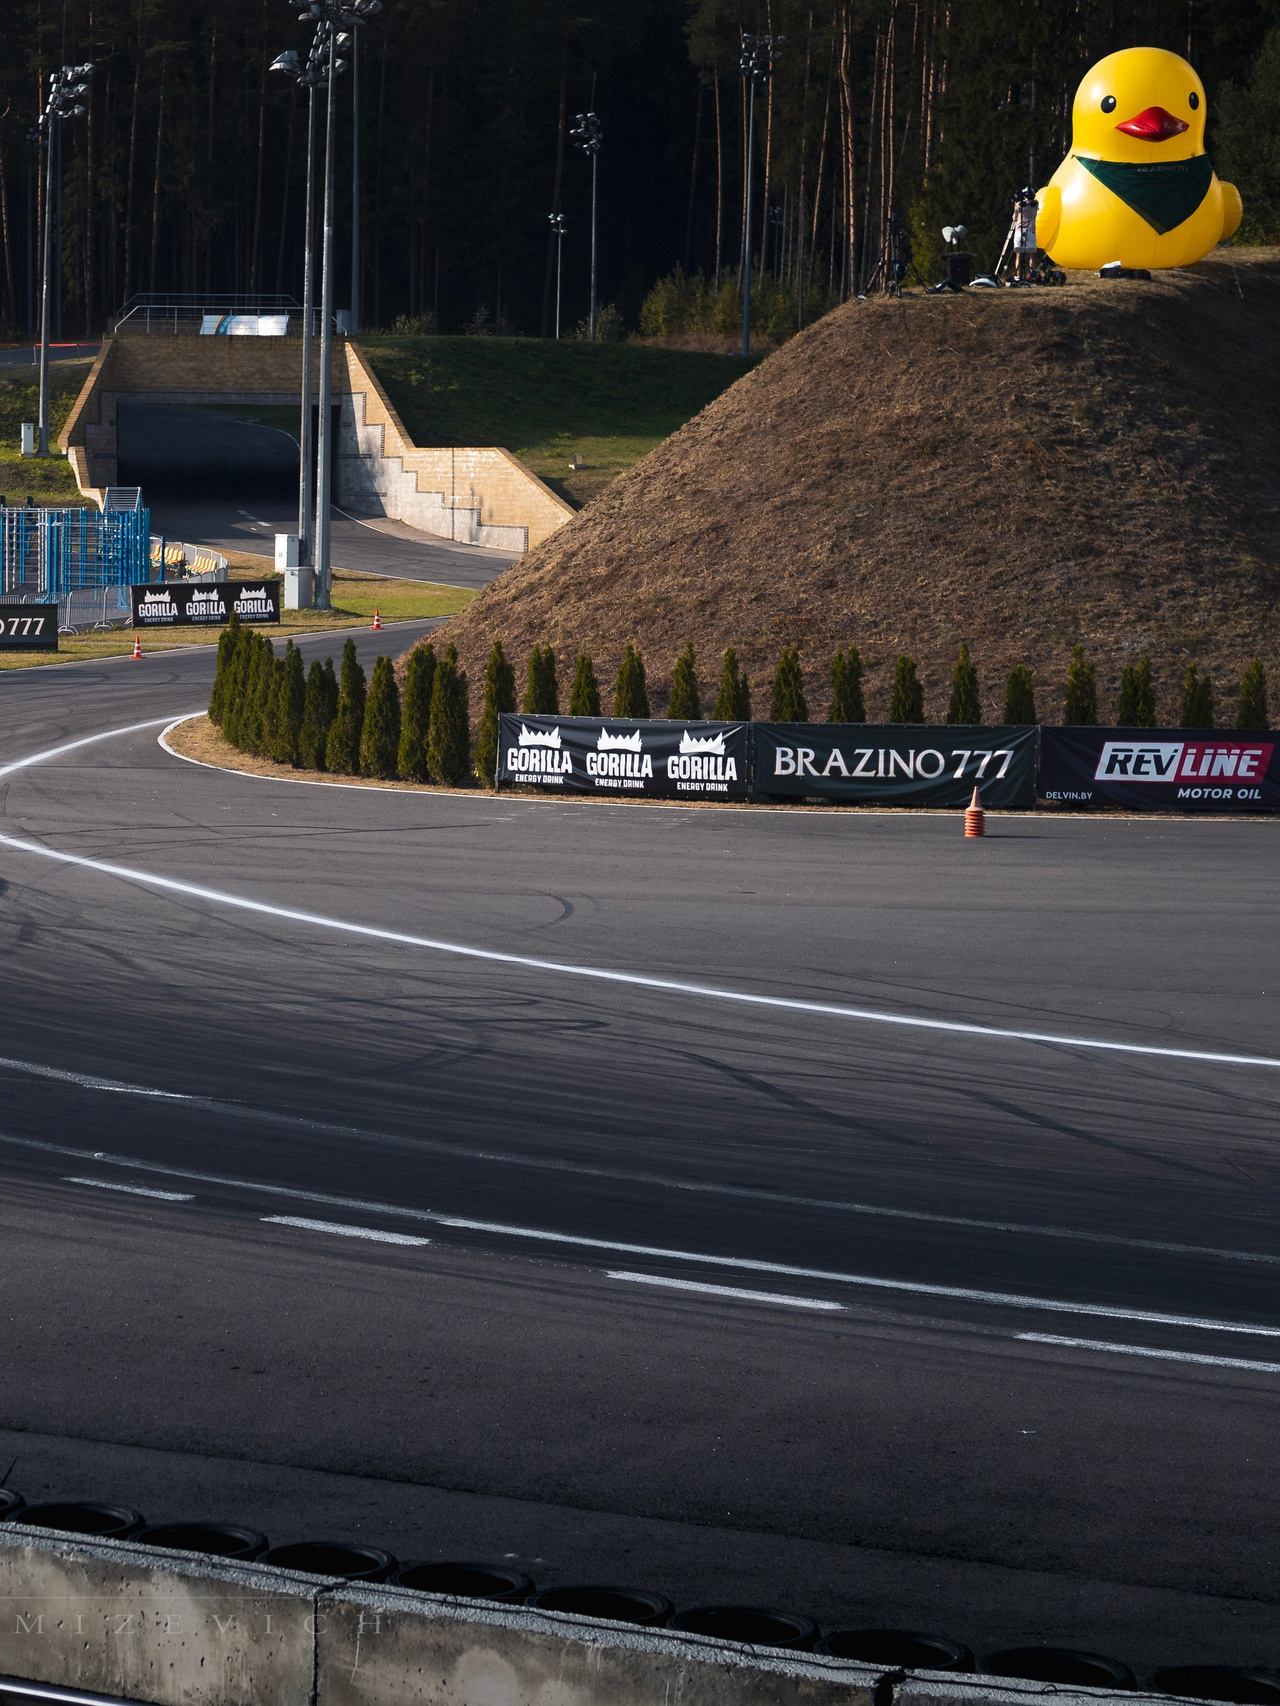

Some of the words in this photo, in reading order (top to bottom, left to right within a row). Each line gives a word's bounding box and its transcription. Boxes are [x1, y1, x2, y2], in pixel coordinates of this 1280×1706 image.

[138, 603, 179, 617] GORILLA
[186, 601, 226, 616] GORILLA
[233, 599, 274, 614] GORILLA
[507, 748, 573, 774] GORILLA
[586, 752, 653, 778] GORILLA
[667, 755, 737, 781] GORILLA
[515, 773, 542, 783] ENERGY
[542, 775, 564, 785] DRINK
[595, 778, 622, 788] ENERGY
[623, 779, 645, 789] DRINK
[676, 781, 705, 791] ENERGY
[705, 782, 728, 792] DRINK
[1177, 788, 1232, 799] MOTOR
[1237, 789, 1262, 799] OIL
[1045, 791, 1093, 800] DELVIN.BY
